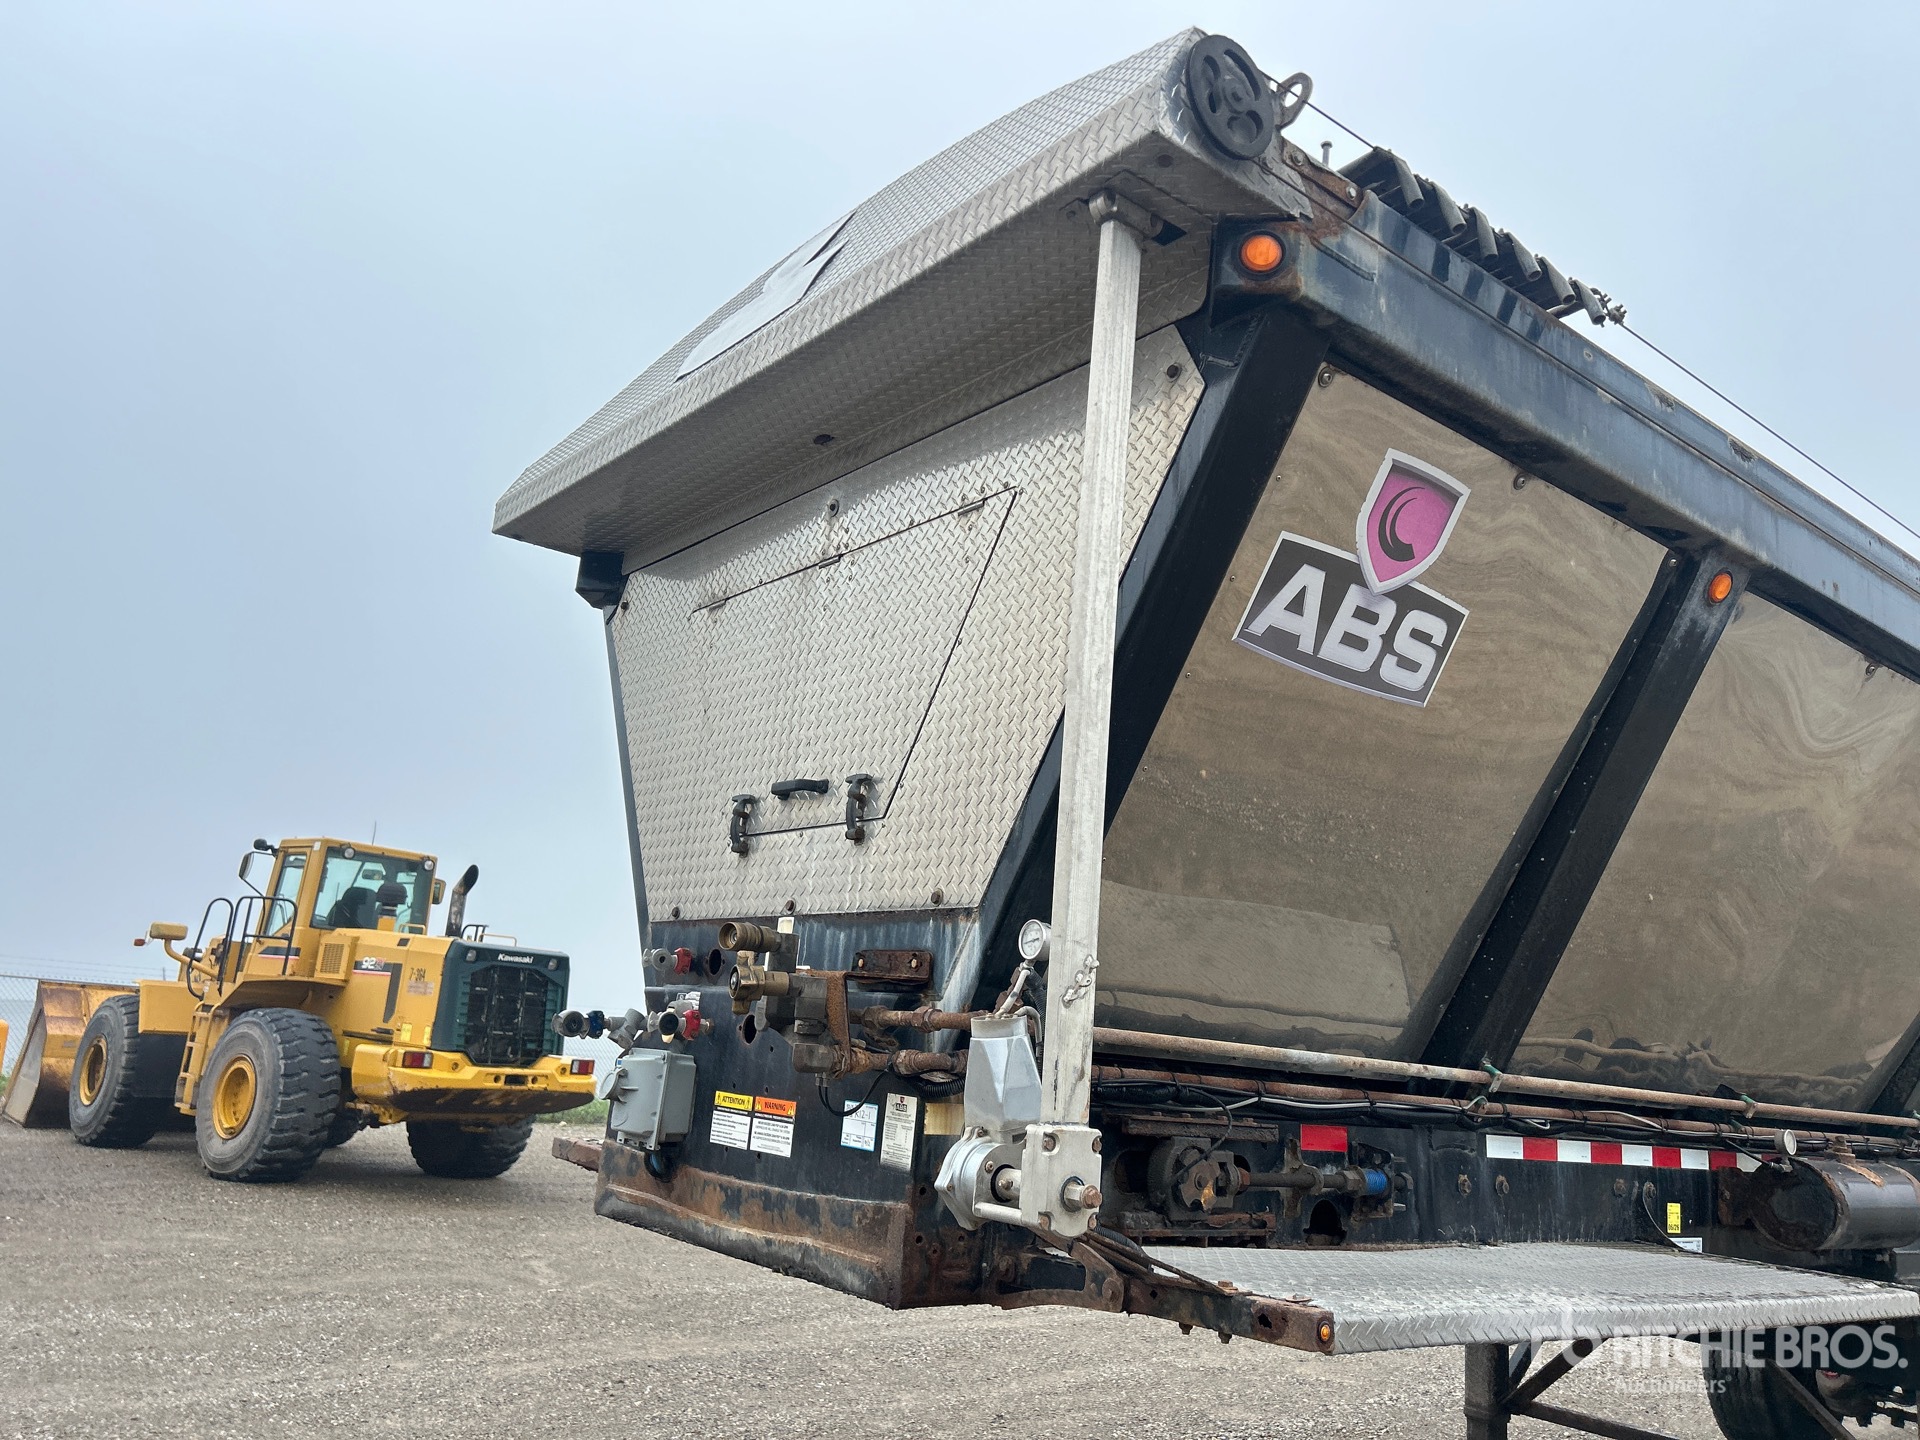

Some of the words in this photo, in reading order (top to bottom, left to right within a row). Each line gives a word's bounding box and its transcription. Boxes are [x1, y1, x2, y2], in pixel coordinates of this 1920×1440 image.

[1243, 563, 1449, 692] ABS
[498, 953, 533, 963] Kawasaki
[721, 1096, 747, 1106] ATTENTION
[764, 1101, 788, 1112] WARNING
